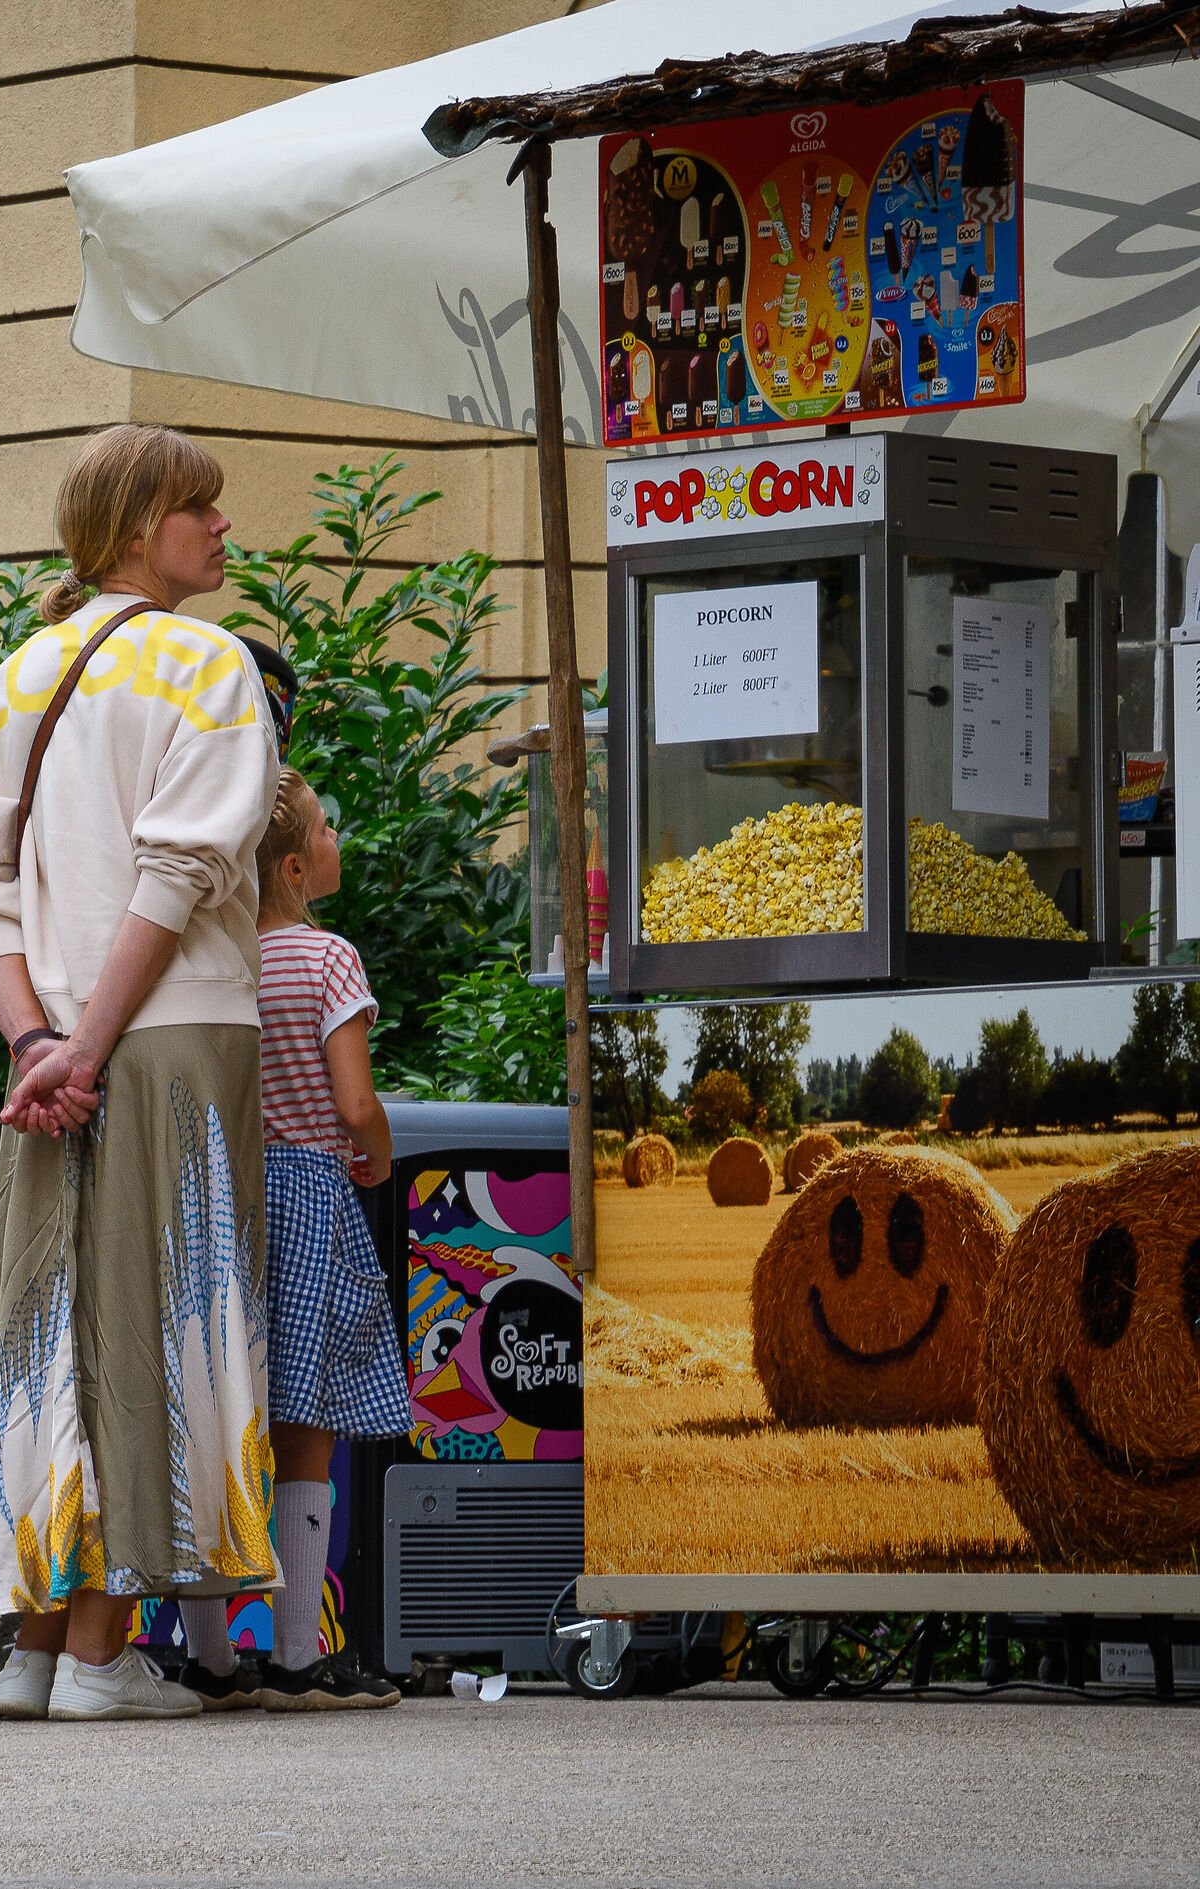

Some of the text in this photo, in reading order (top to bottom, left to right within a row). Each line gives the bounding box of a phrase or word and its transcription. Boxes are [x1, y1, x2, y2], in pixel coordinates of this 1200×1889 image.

[790, 140, 826, 153] ALGIDA
[672, 166, 689, 186] M
[634, 460, 854, 528] POP CORN
[697, 605, 773, 627] POPCORN
[693, 647, 779, 668] 1 Liter 600FT
[693, 676, 779, 696] 2 Liter 800FT
